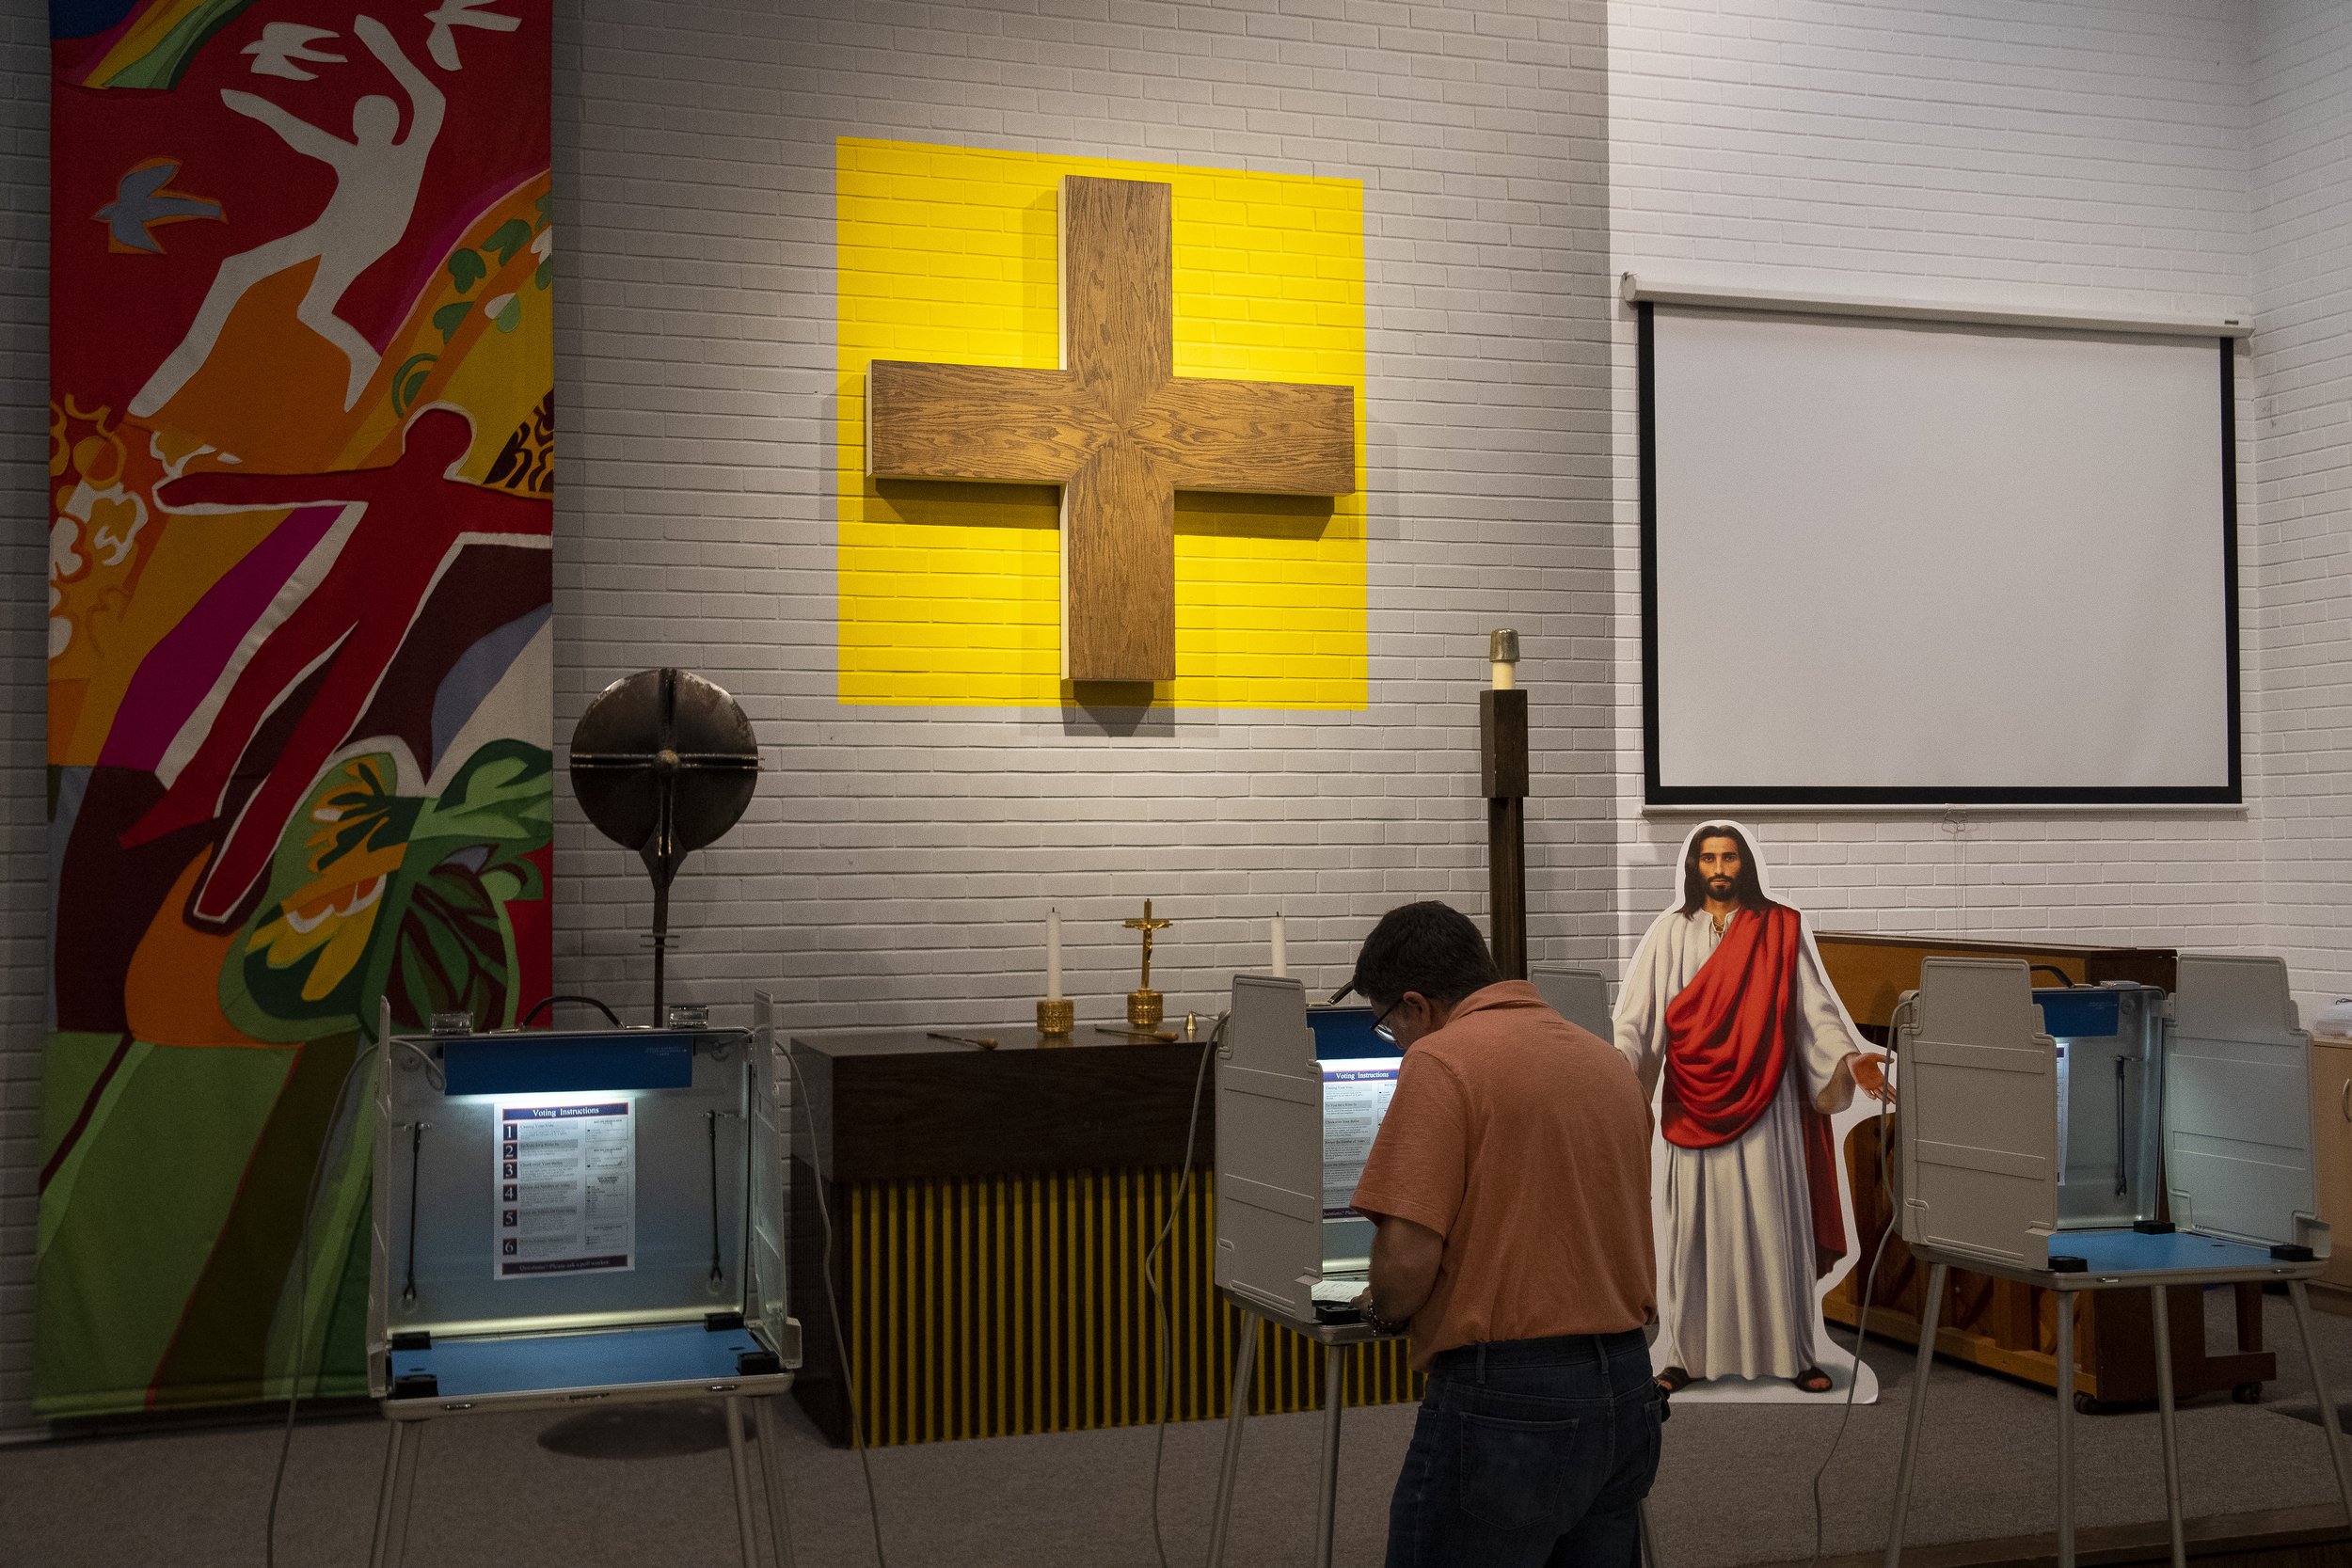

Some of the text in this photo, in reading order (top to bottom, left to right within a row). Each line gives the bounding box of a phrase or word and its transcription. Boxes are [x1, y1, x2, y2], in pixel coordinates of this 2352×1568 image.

[532, 1106, 599, 1118] Voting Instructions
[506, 1126, 512, 1138] 1
[505, 1146, 513, 1158] 2
[505, 1164, 513, 1177] 3
[505, 1187, 514, 1199] 4
[505, 1212, 513, 1225] 5
[505, 1241, 513, 1253] 6
